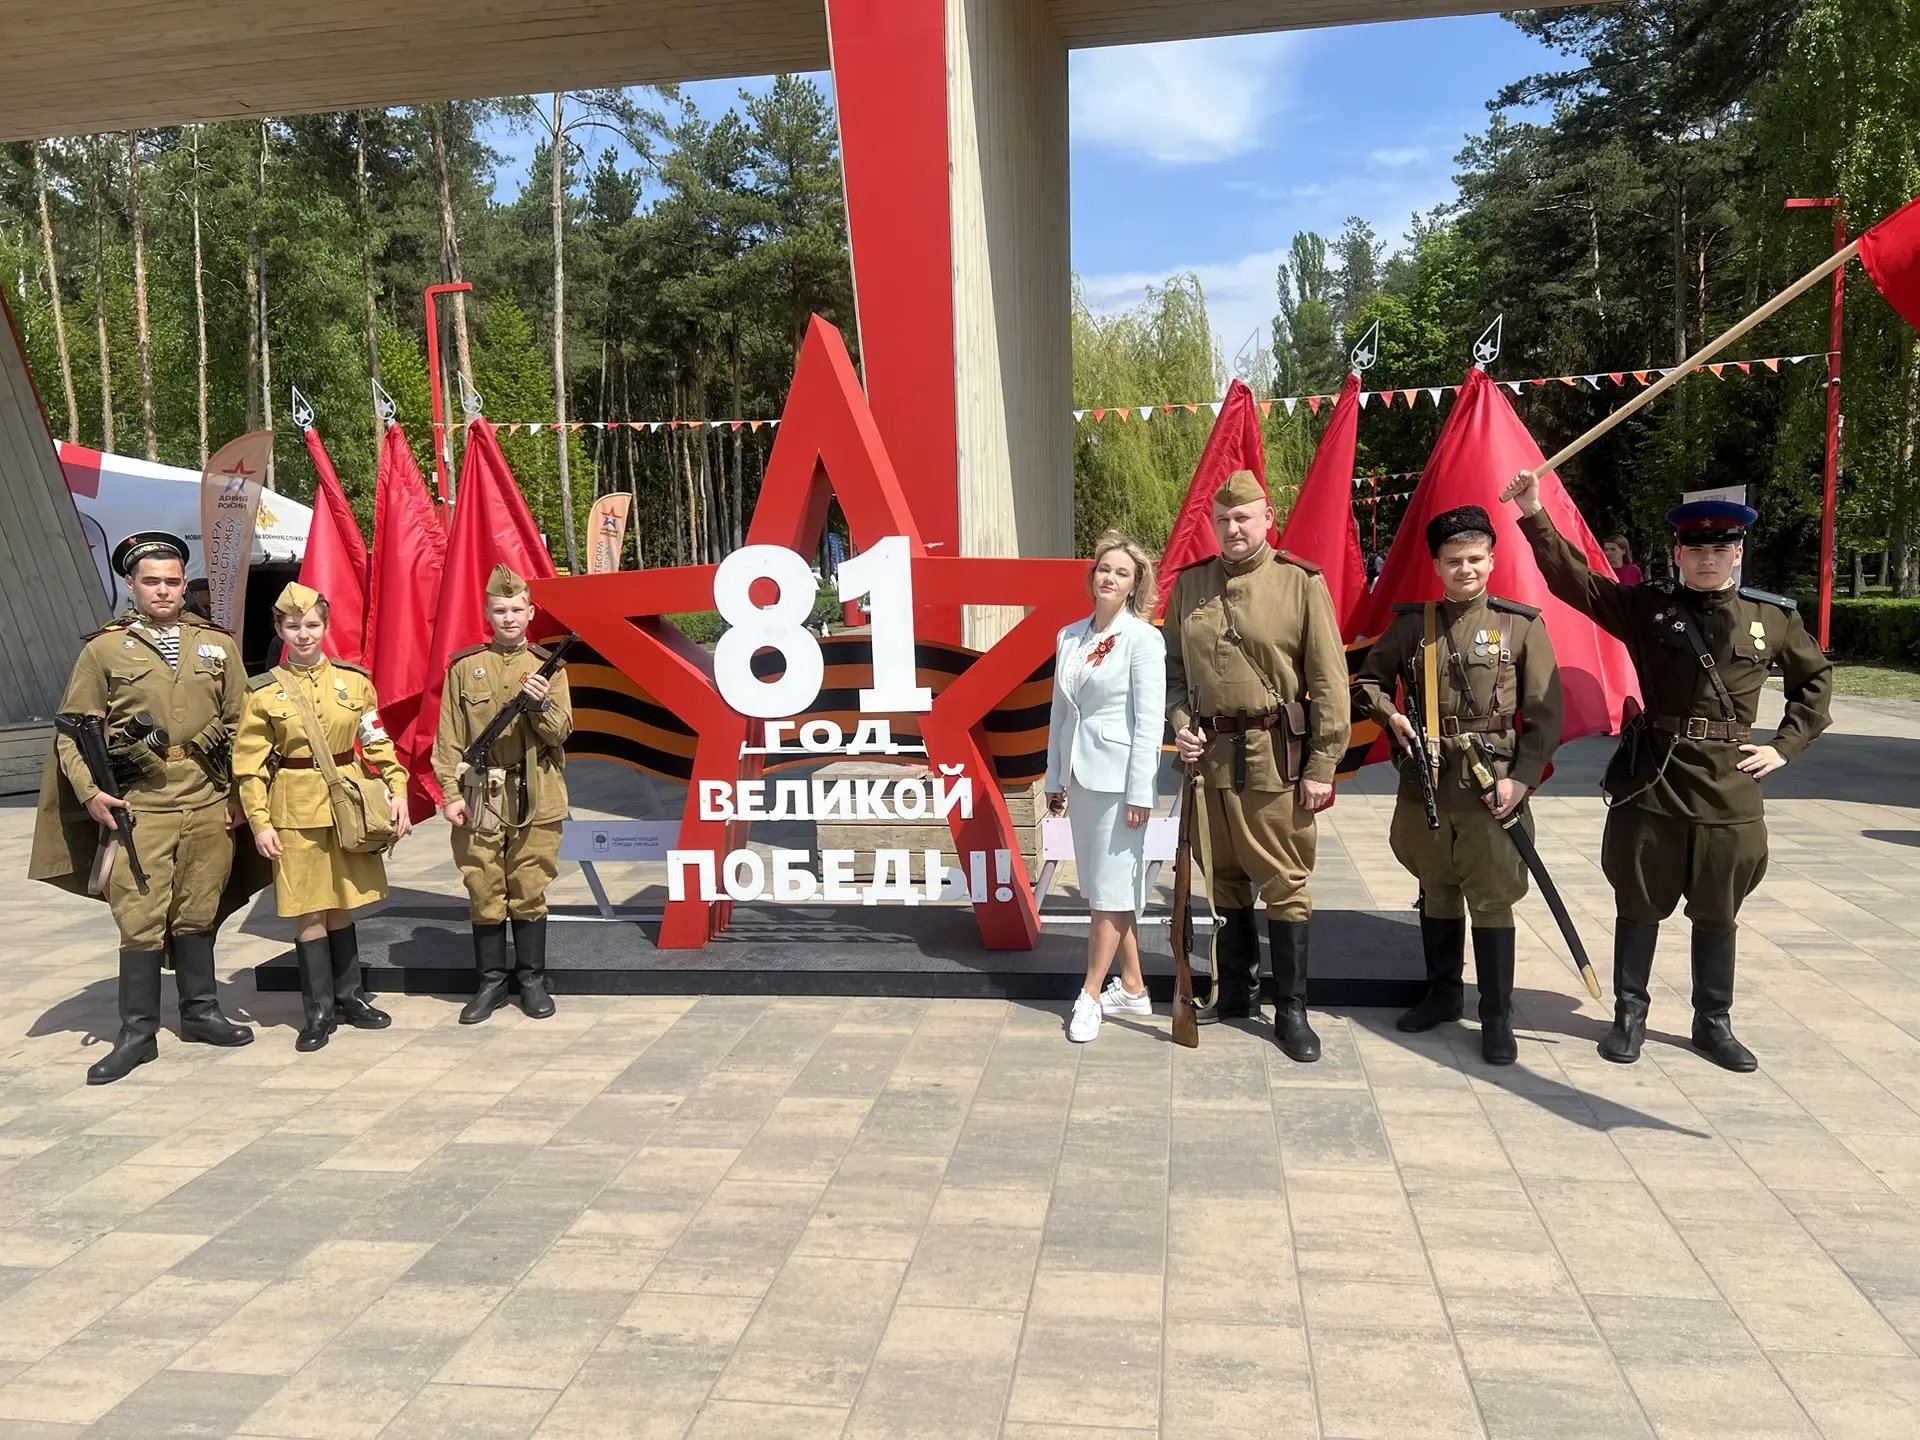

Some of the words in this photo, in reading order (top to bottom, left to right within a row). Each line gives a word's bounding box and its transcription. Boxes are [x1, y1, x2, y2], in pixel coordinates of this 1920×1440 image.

[218, 494, 248, 502] АРМИЯ
[210, 520, 222, 592] ОТБОРА
[220, 516, 235, 569] СЛУЖБУ
[594, 541, 604, 574] ТБОРА
[226, 606, 234, 629] РАКТУ
[712, 535, 933, 718] 81
[763, 719, 899, 756] ГОД
[699, 763, 974, 822] ВЕЛИКОЙ
[666, 848, 1013, 906] ПОБЕДЫ!
